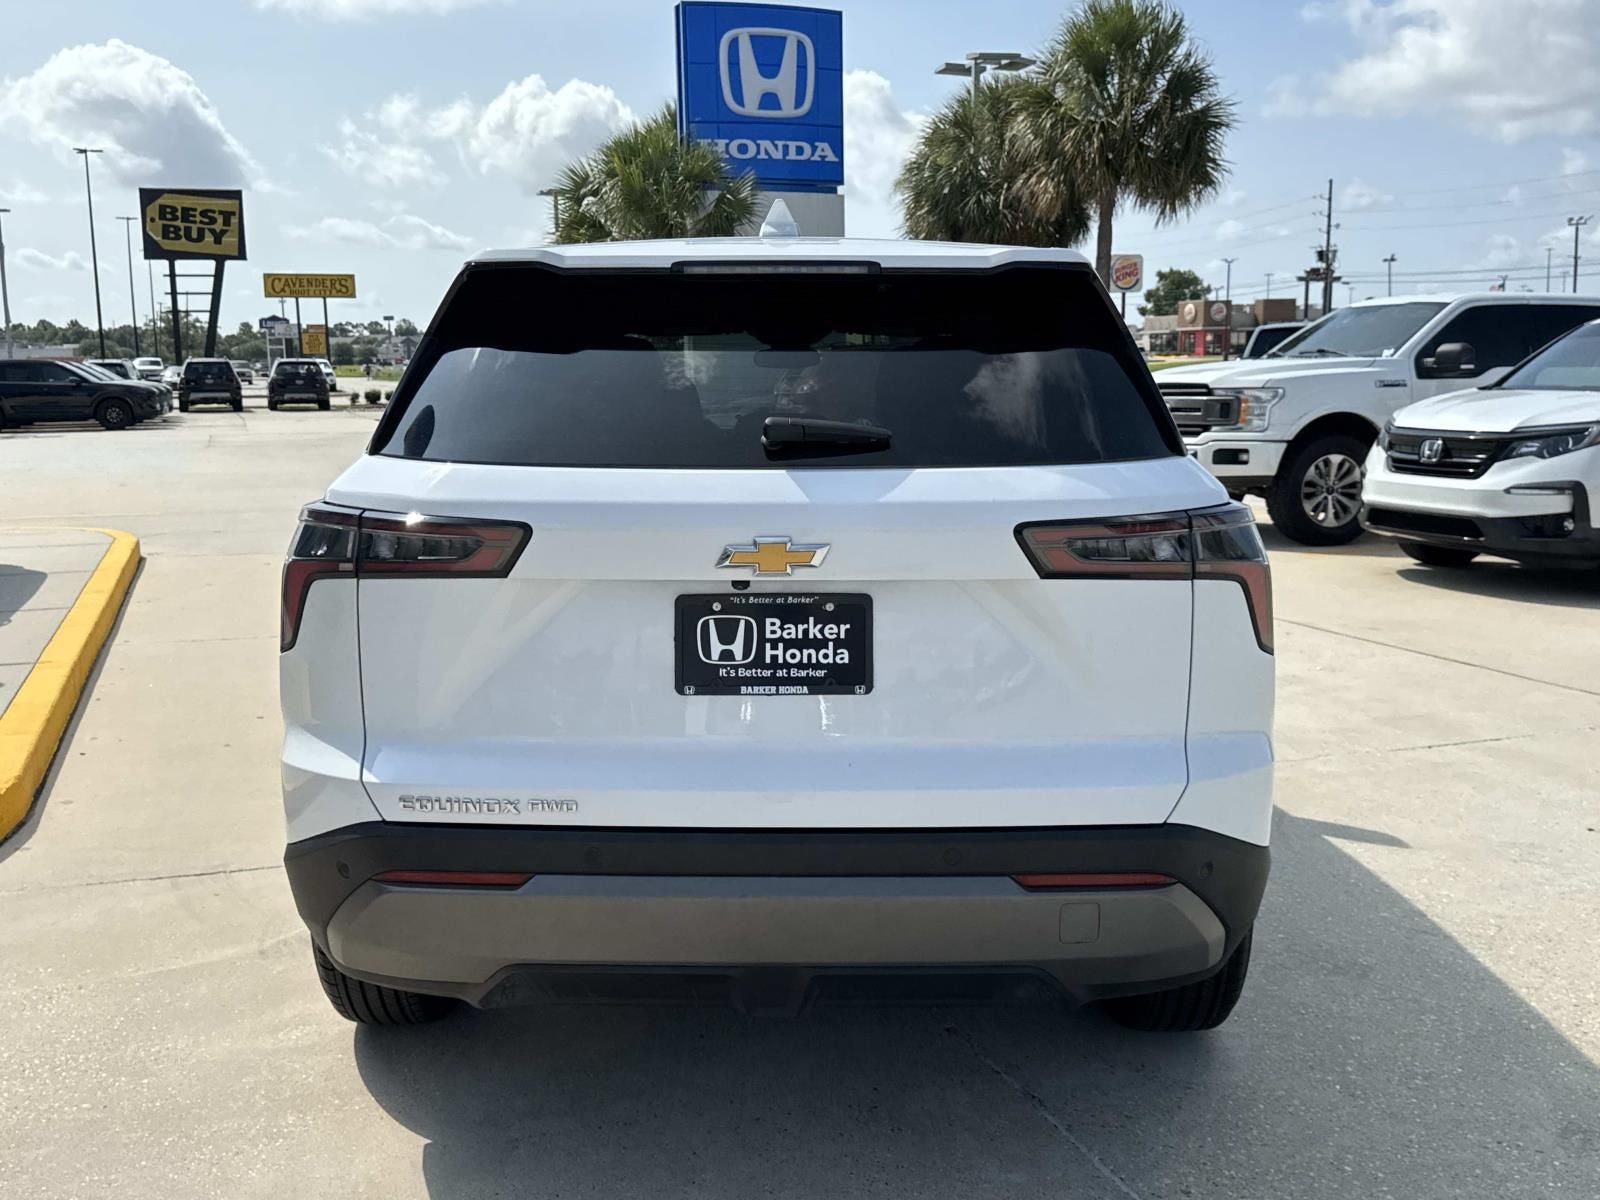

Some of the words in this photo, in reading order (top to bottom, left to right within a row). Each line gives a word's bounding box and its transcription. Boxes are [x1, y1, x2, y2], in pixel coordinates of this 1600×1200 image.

[697, 138, 839, 162] HONDA
[158, 204, 237, 227] BEST
[161, 223, 230, 246] BUY
[1115, 268, 1139, 282] KING
[271, 276, 350, 295] CAVENDER'S
[748, 596, 774, 604] Better
[775, 596, 786, 604] at
[765, 616, 851, 639] Barker
[765, 641, 850, 664] Honda
[719, 667, 736, 677] It's
[738, 667, 774, 677] Better
[776, 667, 788, 677] at
[790, 667, 828, 677] Barker
[740, 685, 776, 694] BARKER
[778, 685, 809, 694] HONDA
[399, 794, 521, 814] EQUINOX
[527, 798, 578, 812] AWD
